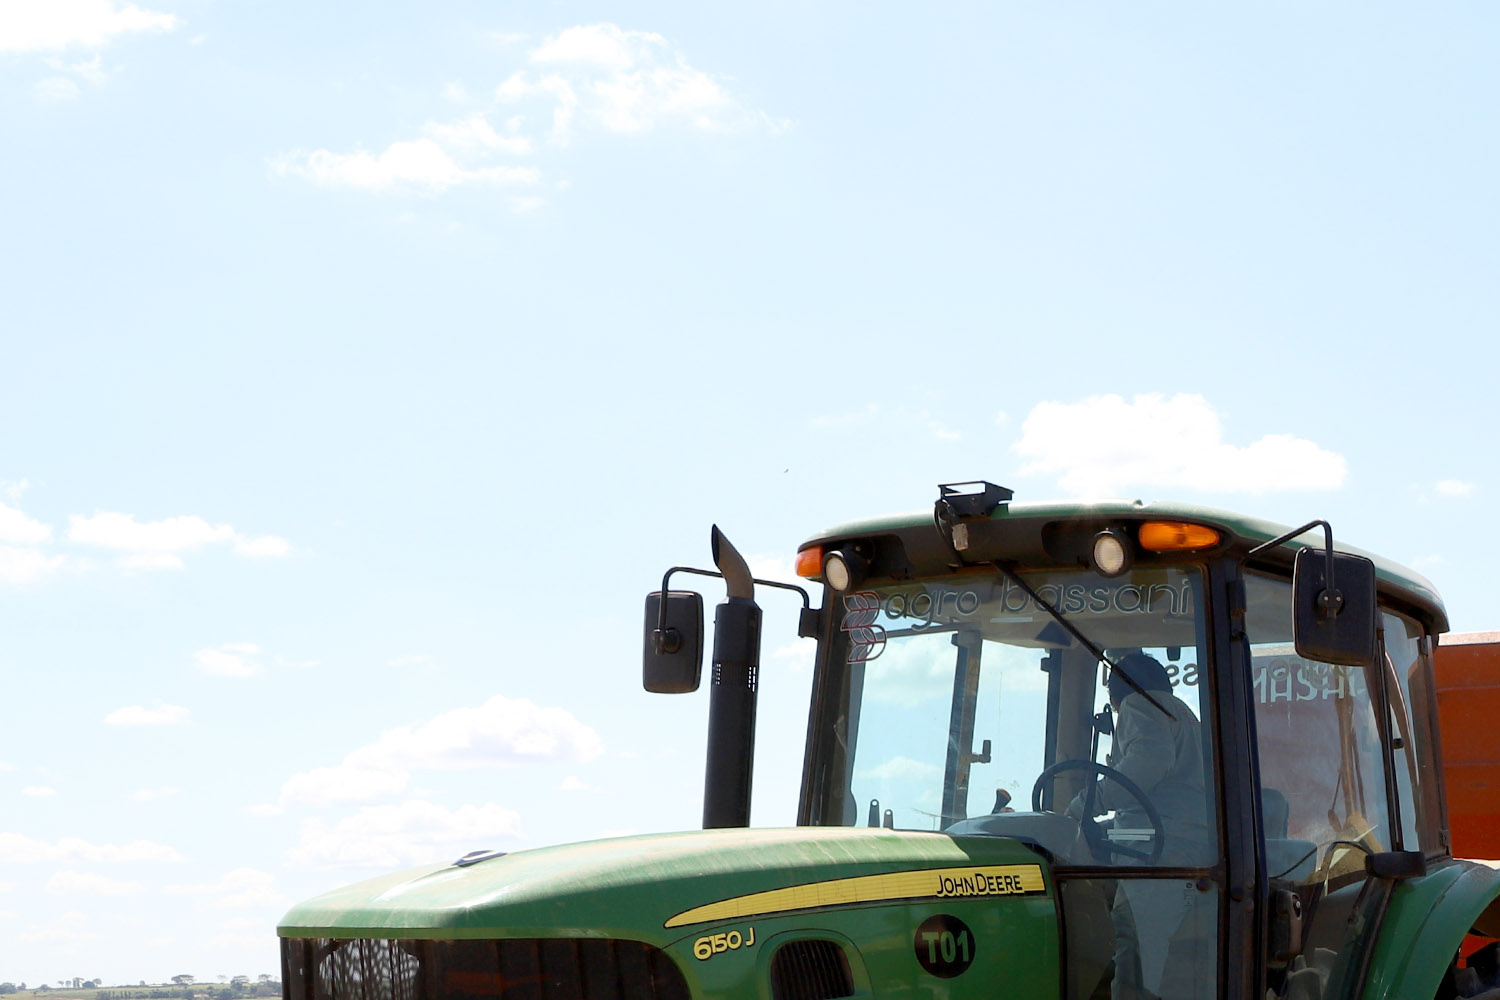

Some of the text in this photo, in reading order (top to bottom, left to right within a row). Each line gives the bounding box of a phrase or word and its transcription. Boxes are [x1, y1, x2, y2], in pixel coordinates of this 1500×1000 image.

[885, 574, 1190, 630] agro bassani
[936, 873, 1023, 896] JOHN DEERE
[694, 931, 742, 960] 6150
[921, 930, 969, 964] T01
